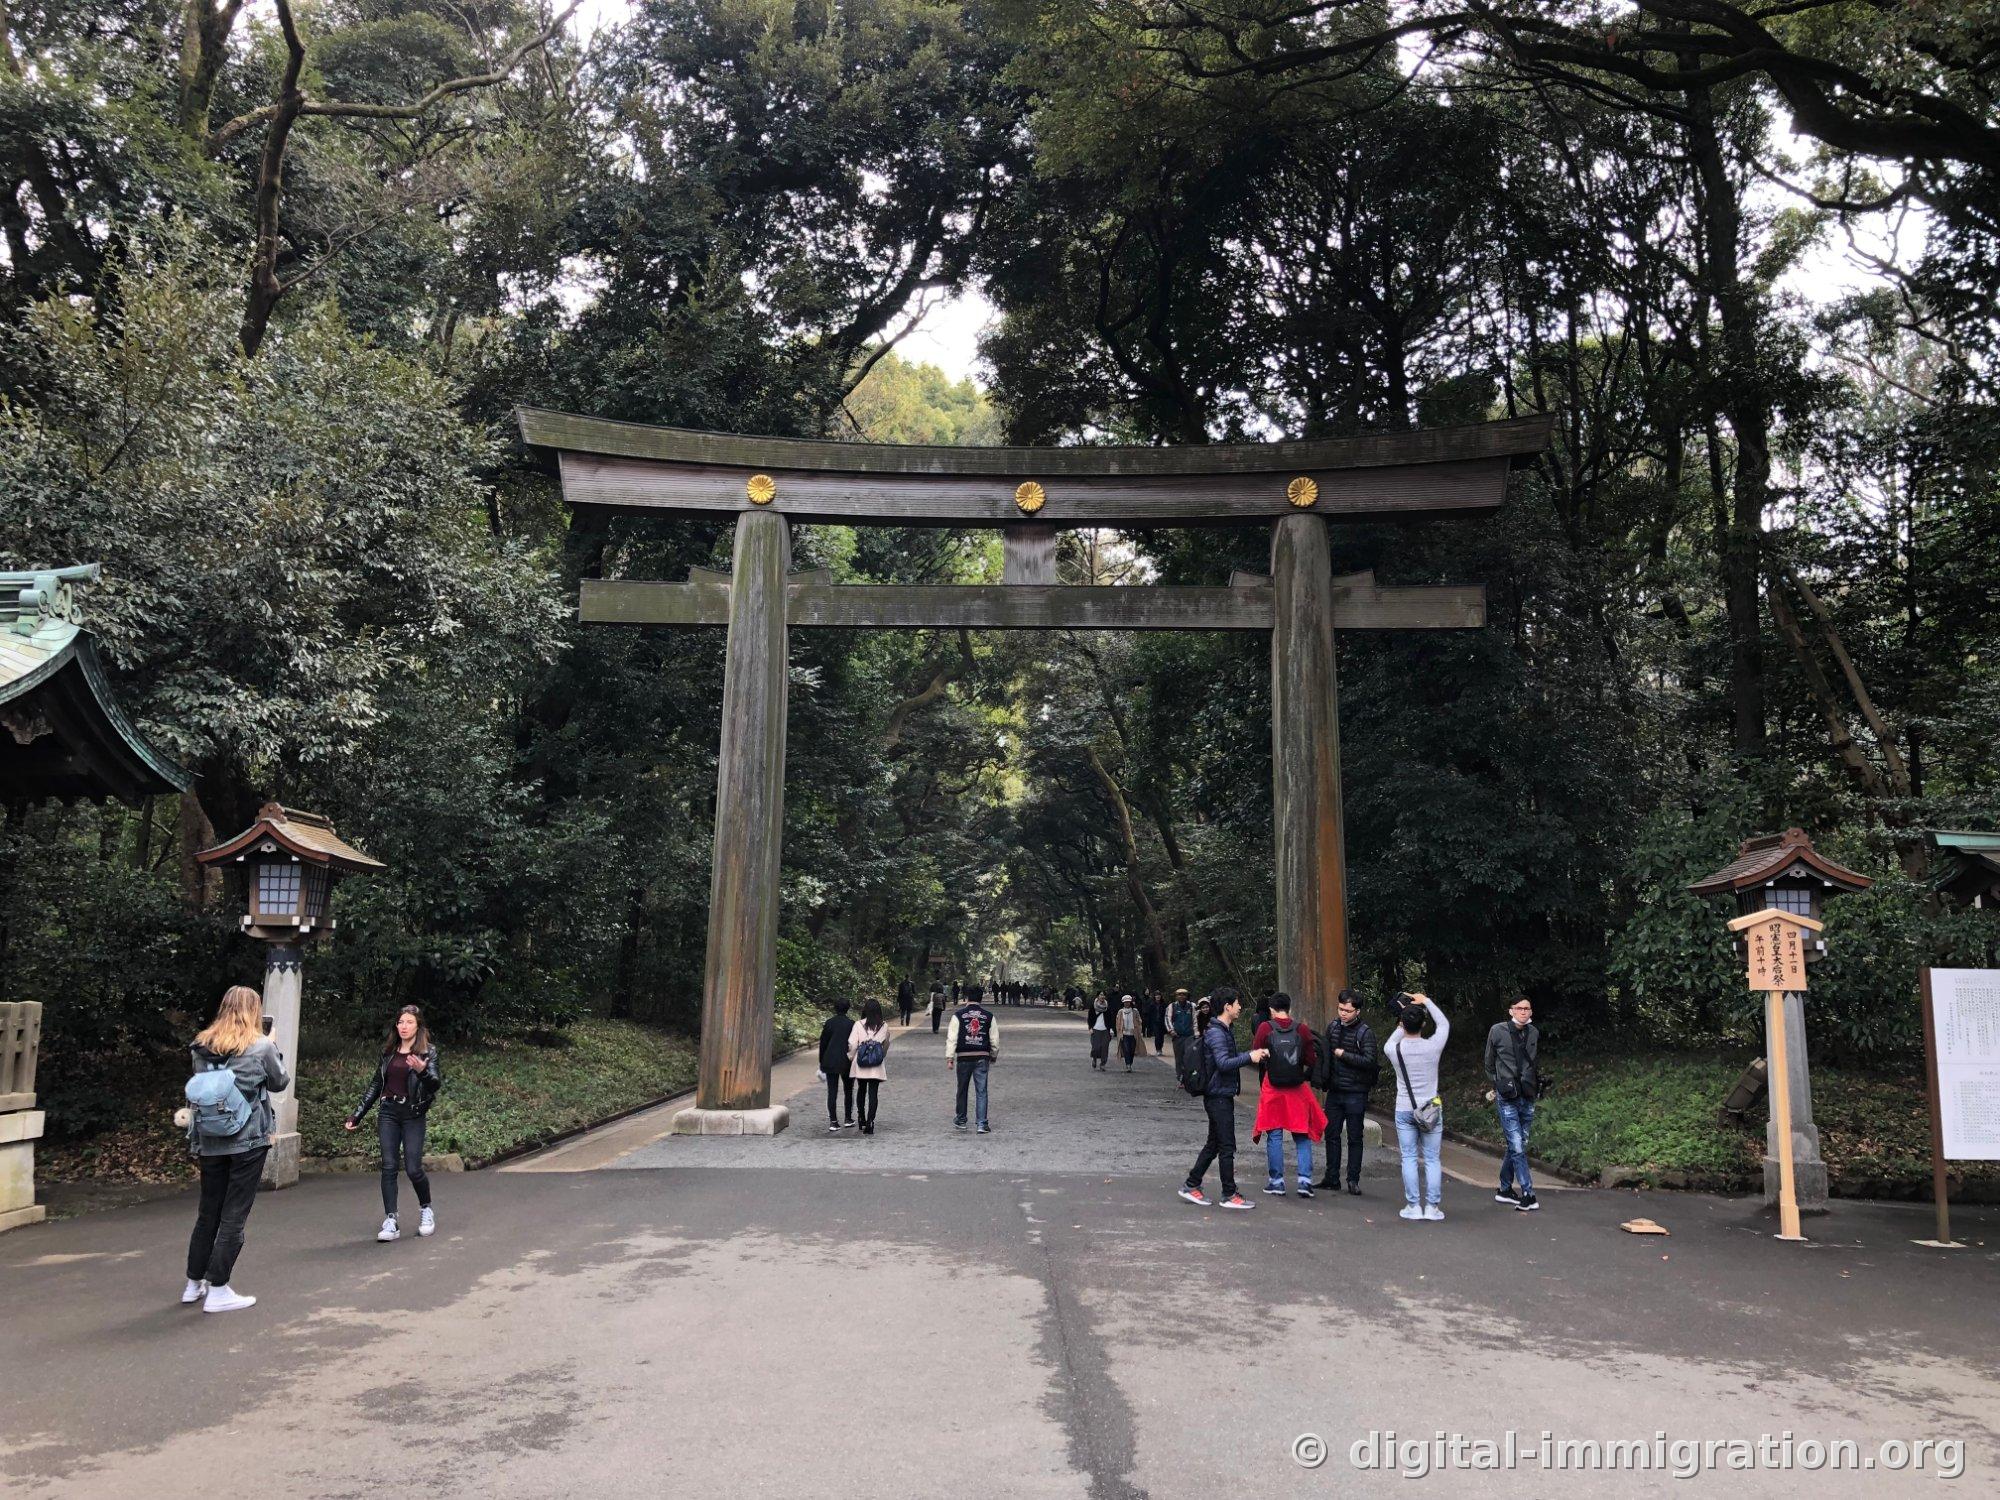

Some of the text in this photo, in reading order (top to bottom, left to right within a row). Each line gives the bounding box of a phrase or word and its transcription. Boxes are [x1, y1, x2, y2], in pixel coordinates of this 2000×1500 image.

[1755, 934, 1766, 976] 午前十時
[1787, 931, 1797, 973] 四月十一日
